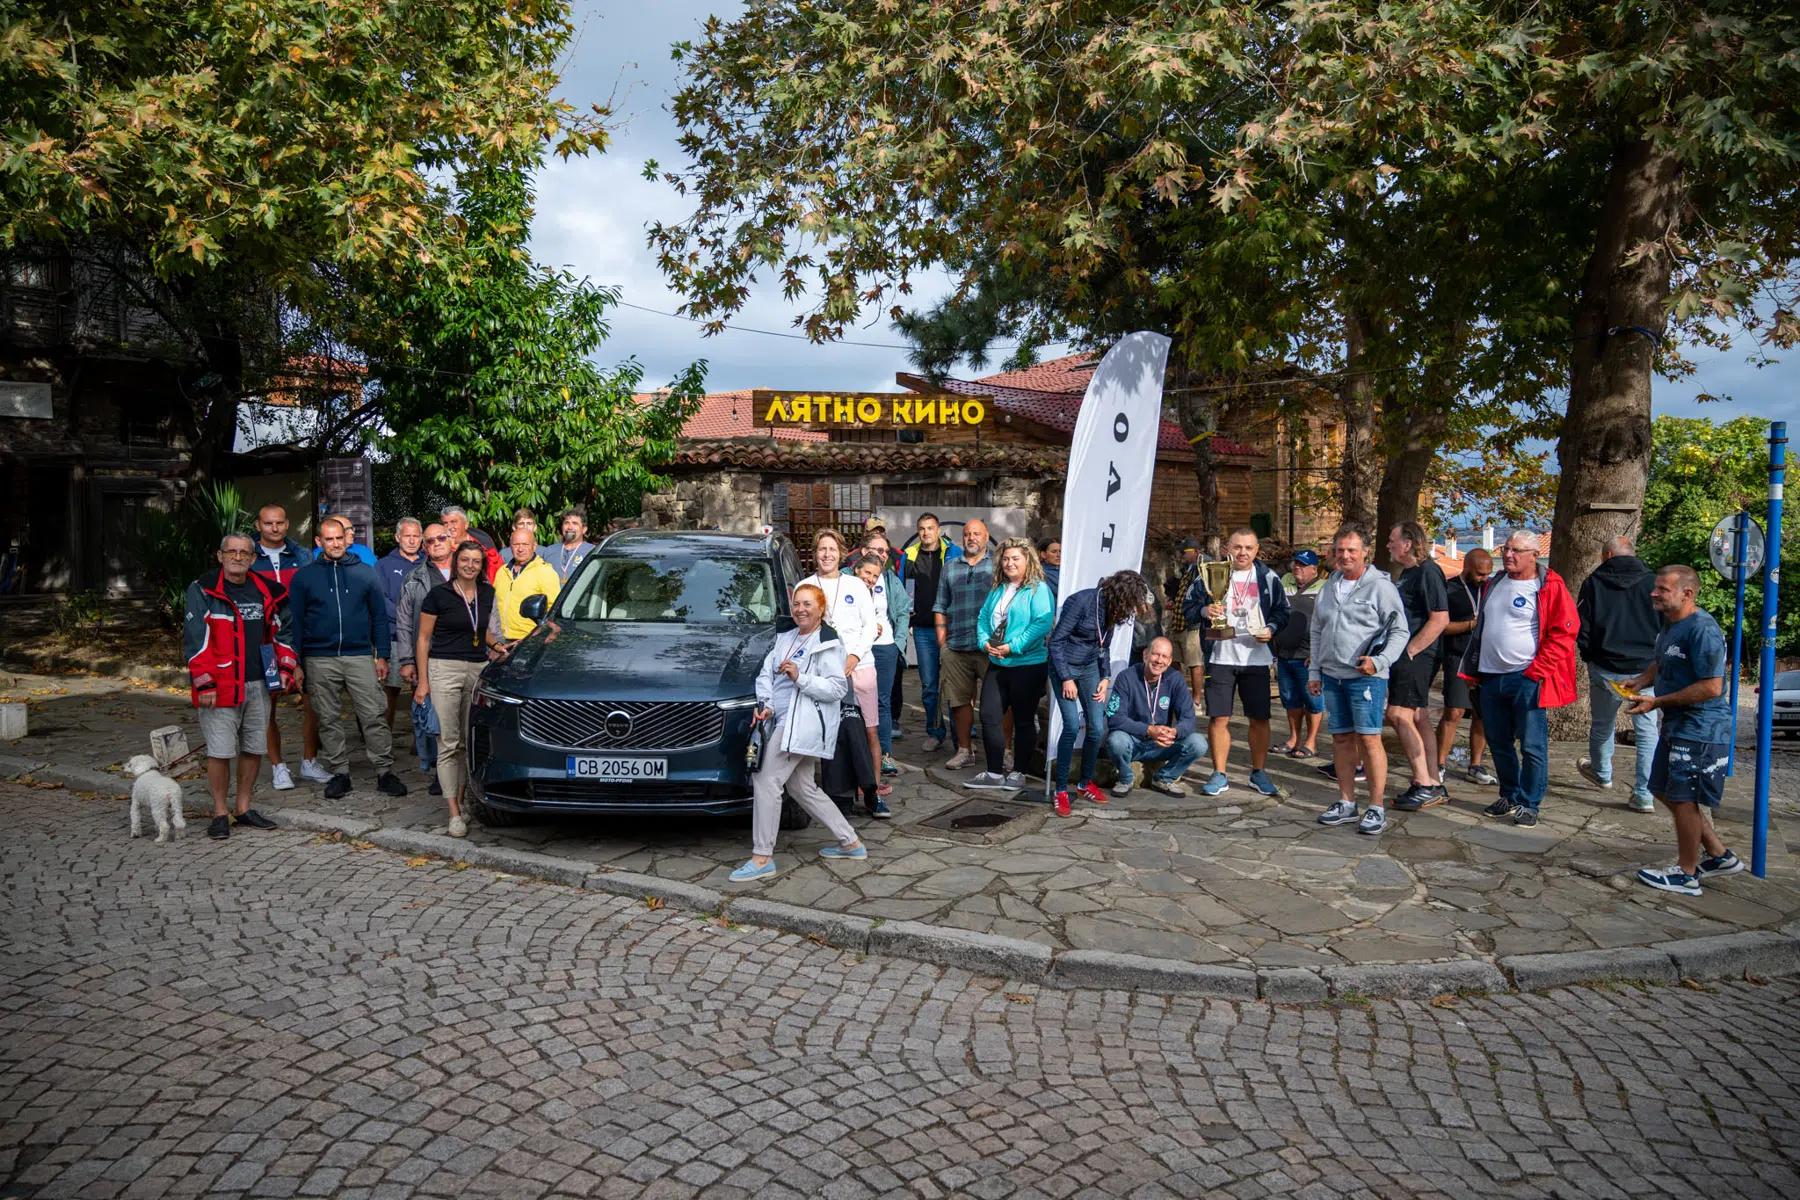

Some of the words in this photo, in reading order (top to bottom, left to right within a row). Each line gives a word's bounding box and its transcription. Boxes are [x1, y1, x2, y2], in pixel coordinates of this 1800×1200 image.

[764, 395, 882, 424] ЛЯТНО
[892, 398, 985, 425] КИНО
[1099, 412, 1130, 578] LVO
[578, 760, 599, 775] CB
[601, 760, 640, 776] 2056
[643, 761, 664, 776] OM
